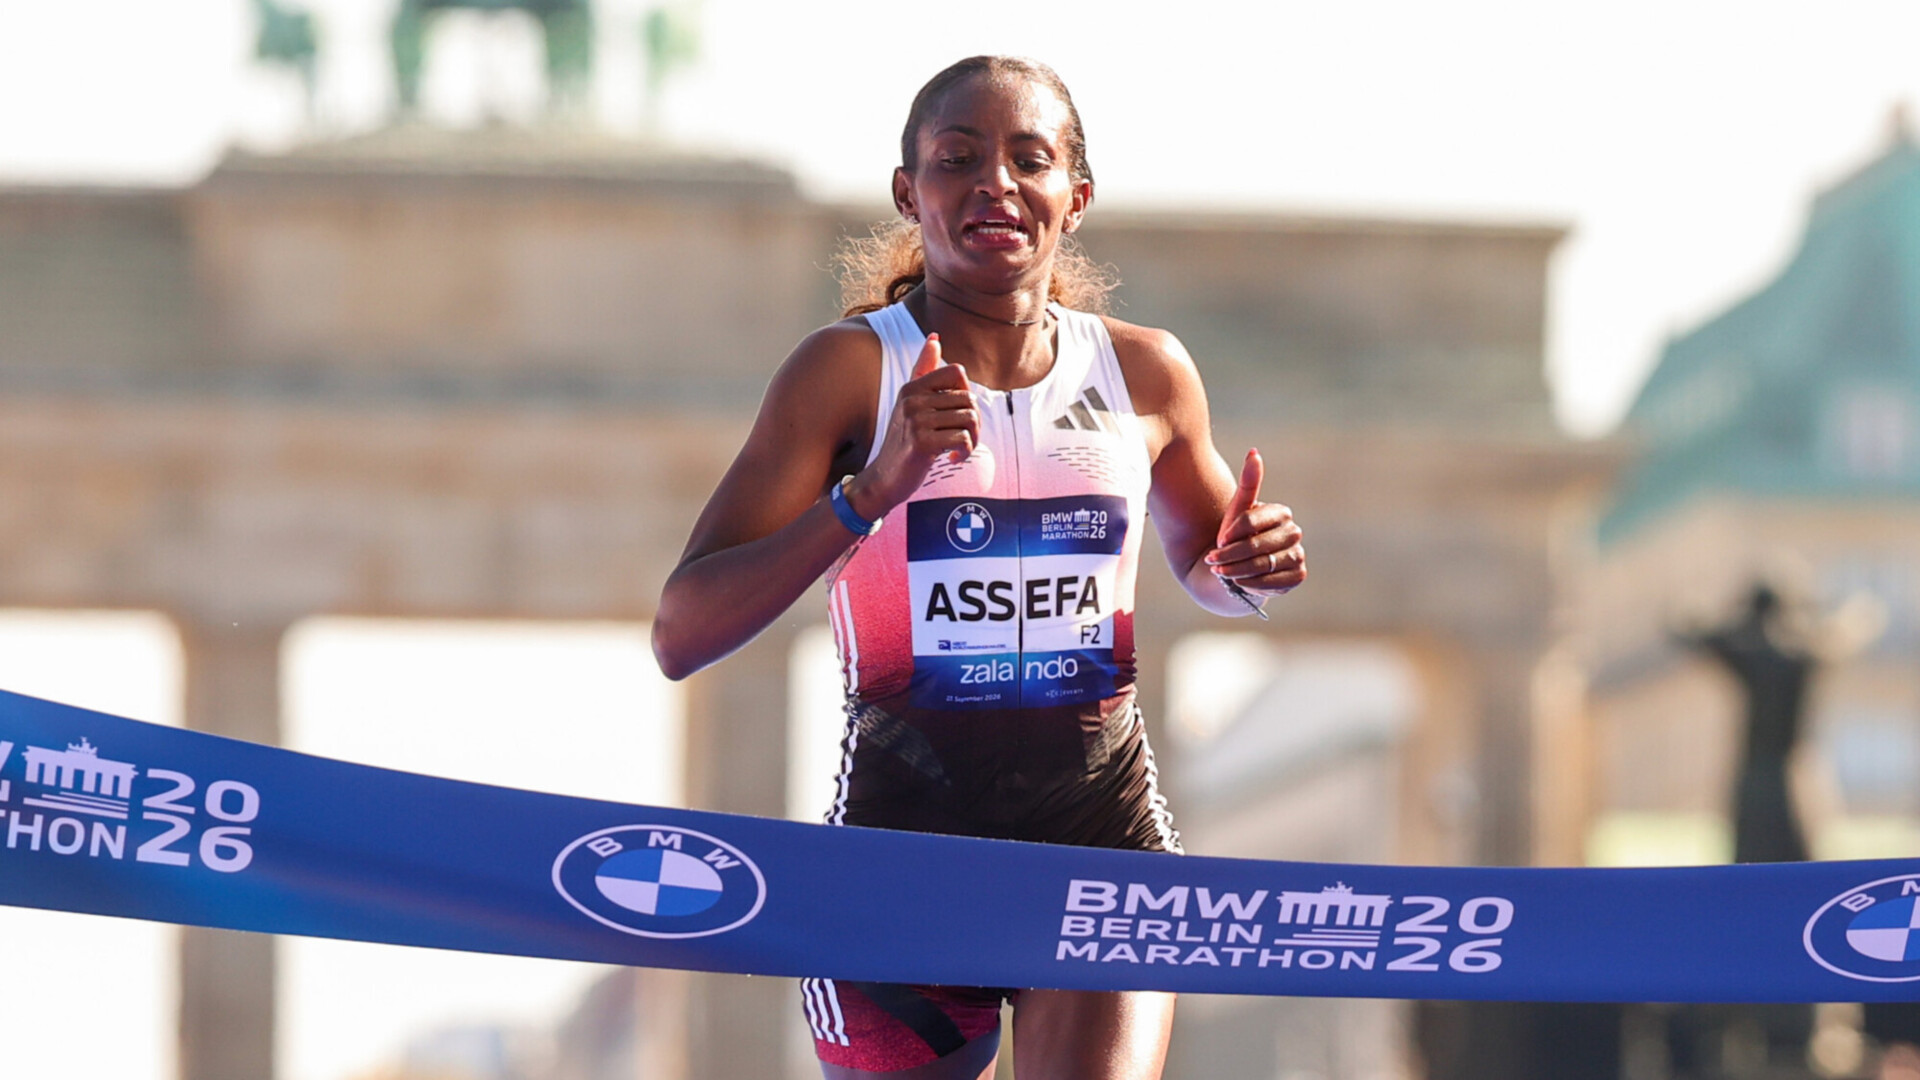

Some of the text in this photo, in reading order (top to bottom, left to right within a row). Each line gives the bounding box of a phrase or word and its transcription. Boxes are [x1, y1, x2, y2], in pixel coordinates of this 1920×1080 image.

[953, 505, 988, 520] BMW
[1042, 511, 1073, 524] BMW
[1091, 510, 1108, 525] 20
[1042, 523, 1073, 533] BERLIN
[1042, 531, 1090, 541] MARATHON
[1089, 525, 1106, 539] 26
[925, 575, 1100, 622] ASSEFA
[1080, 624, 1101, 645] F2
[960, 655, 1079, 684] zalando
[143, 768, 260, 823] 20
[0, 810, 128, 860] HON
[136, 811, 254, 873] 26
[586, 831, 742, 871] BMW
[1065, 879, 1269, 921] BMW
[1060, 915, 1263, 944] BERLIN
[1395, 896, 1515, 934] 20
[1055, 940, 1377, 970] MARATHON
[1386, 936, 1503, 973] 26
